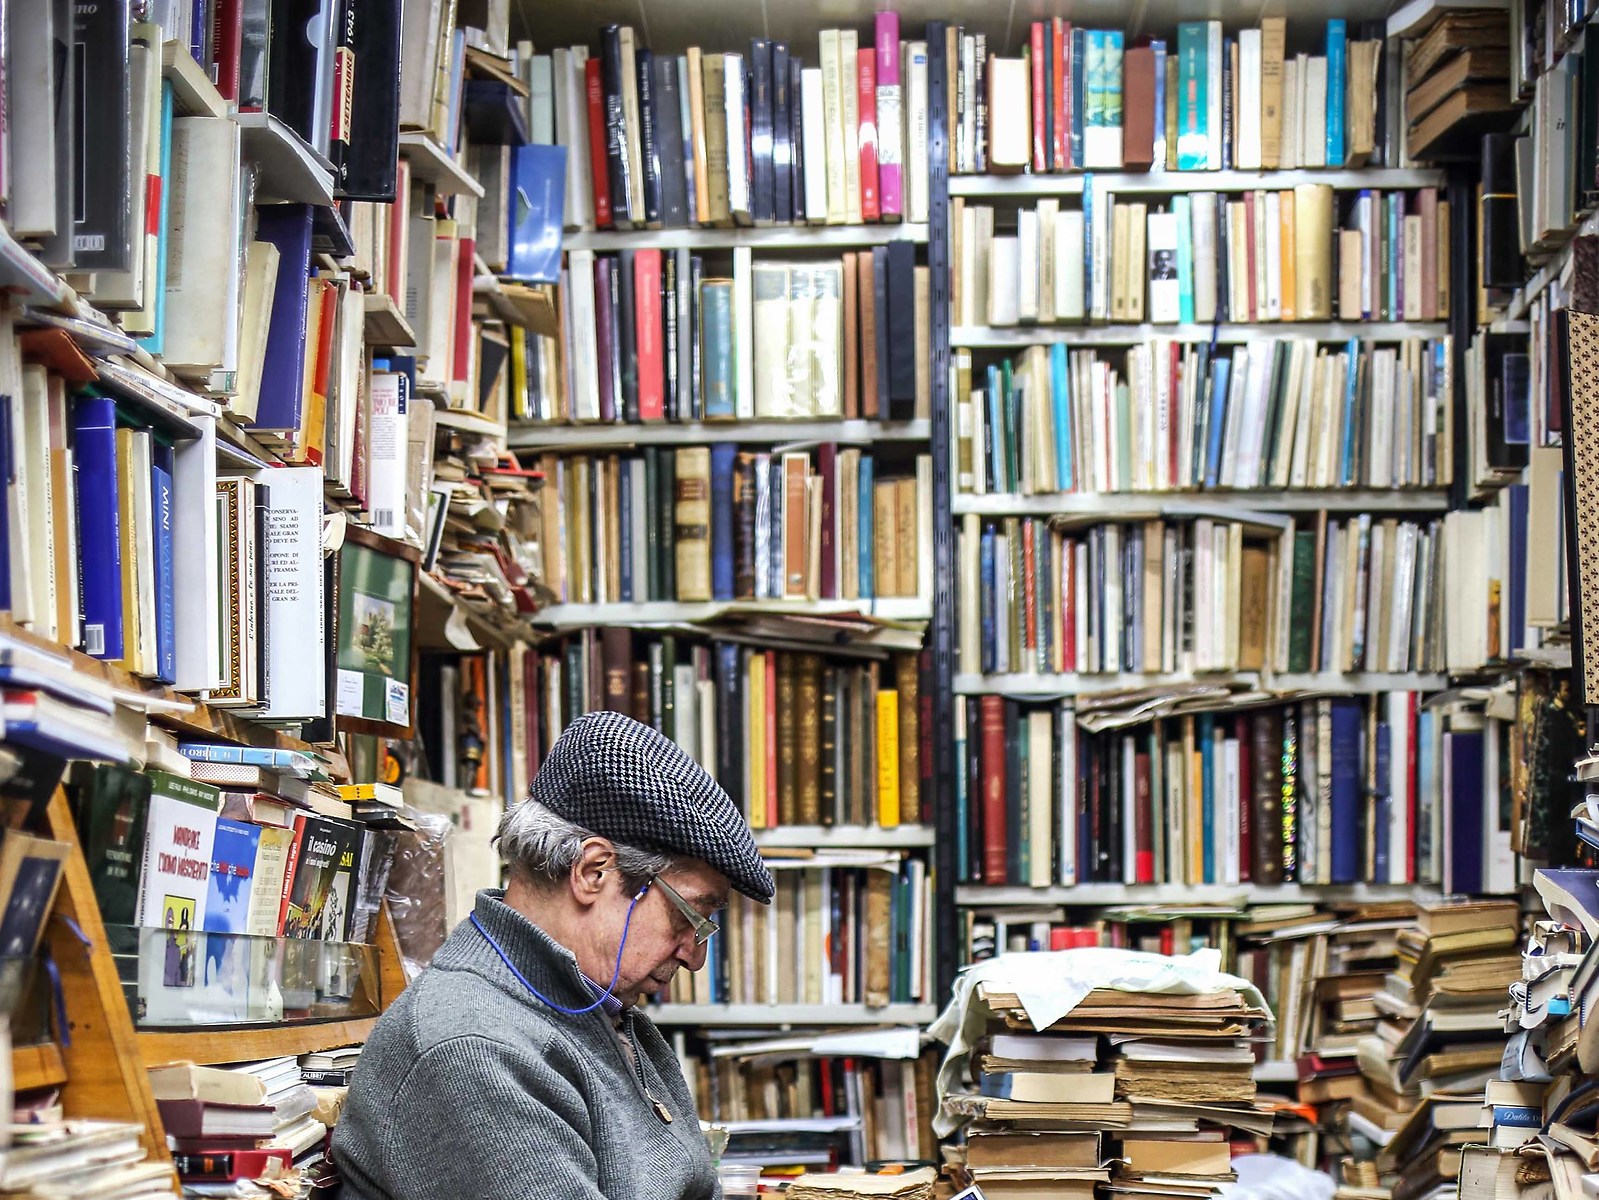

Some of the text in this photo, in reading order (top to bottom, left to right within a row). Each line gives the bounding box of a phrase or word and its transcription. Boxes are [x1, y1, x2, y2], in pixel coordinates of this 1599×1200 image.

[347, 10, 355, 44] 1943
[344, 52, 353, 127] SETTEMBRE
[162, 486, 170, 530] MINI
[188, 748, 217, 760] LIBRO
[307, 835, 338, 857] il casinò
[1503, 1111, 1530, 1122] Dalila
